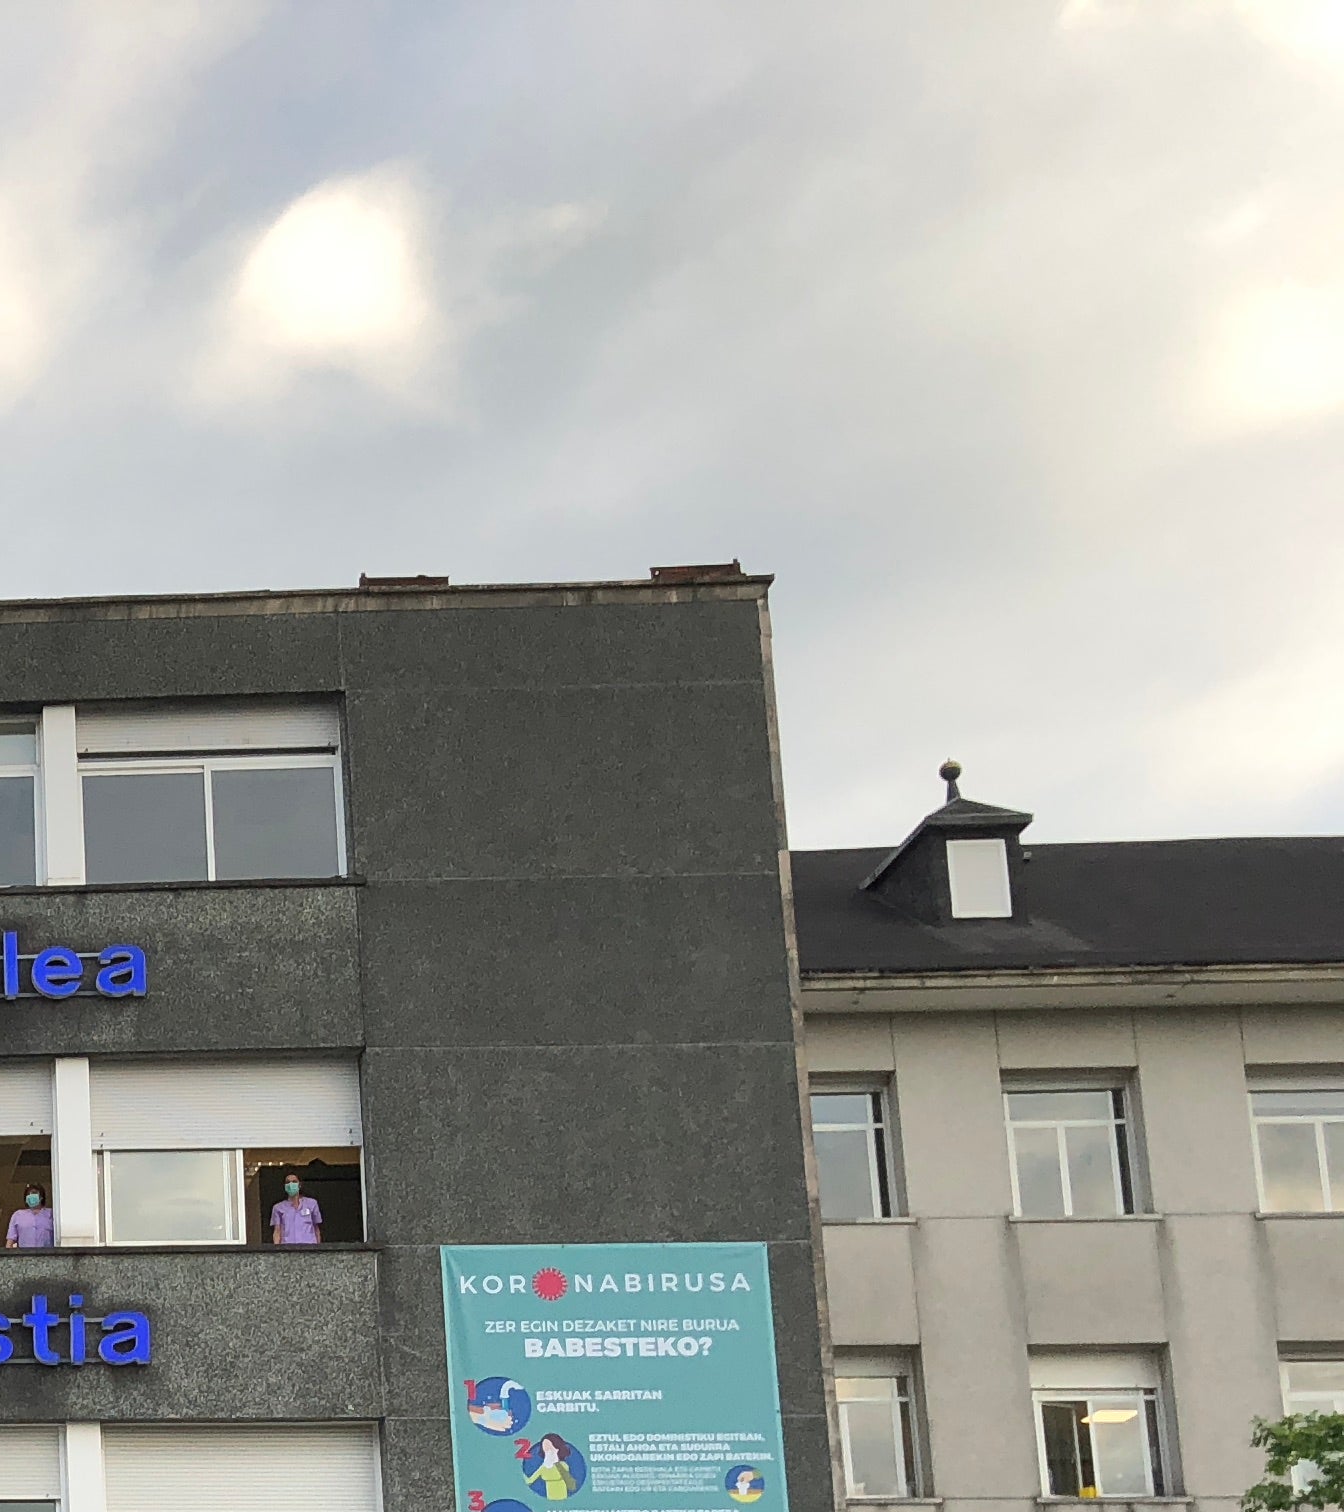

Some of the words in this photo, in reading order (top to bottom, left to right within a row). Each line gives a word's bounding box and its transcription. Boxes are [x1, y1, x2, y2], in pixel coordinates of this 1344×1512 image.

[485, 1321, 516, 1333] ZER
[520, 1320, 559, 1333] EGIN
[562, 1319, 636, 1332] DEZAKET
[640, 1319, 679, 1331] NIRE
[682, 1318, 740, 1331] BURUA
[524, 1337, 712, 1358] BABESTEKO?
[464, 1379, 476, 1400] 1
[536, 1390, 592, 1400] ESKUAK
[515, 1438, 531, 1459] 2
[468, 1491, 485, 1511] 3
